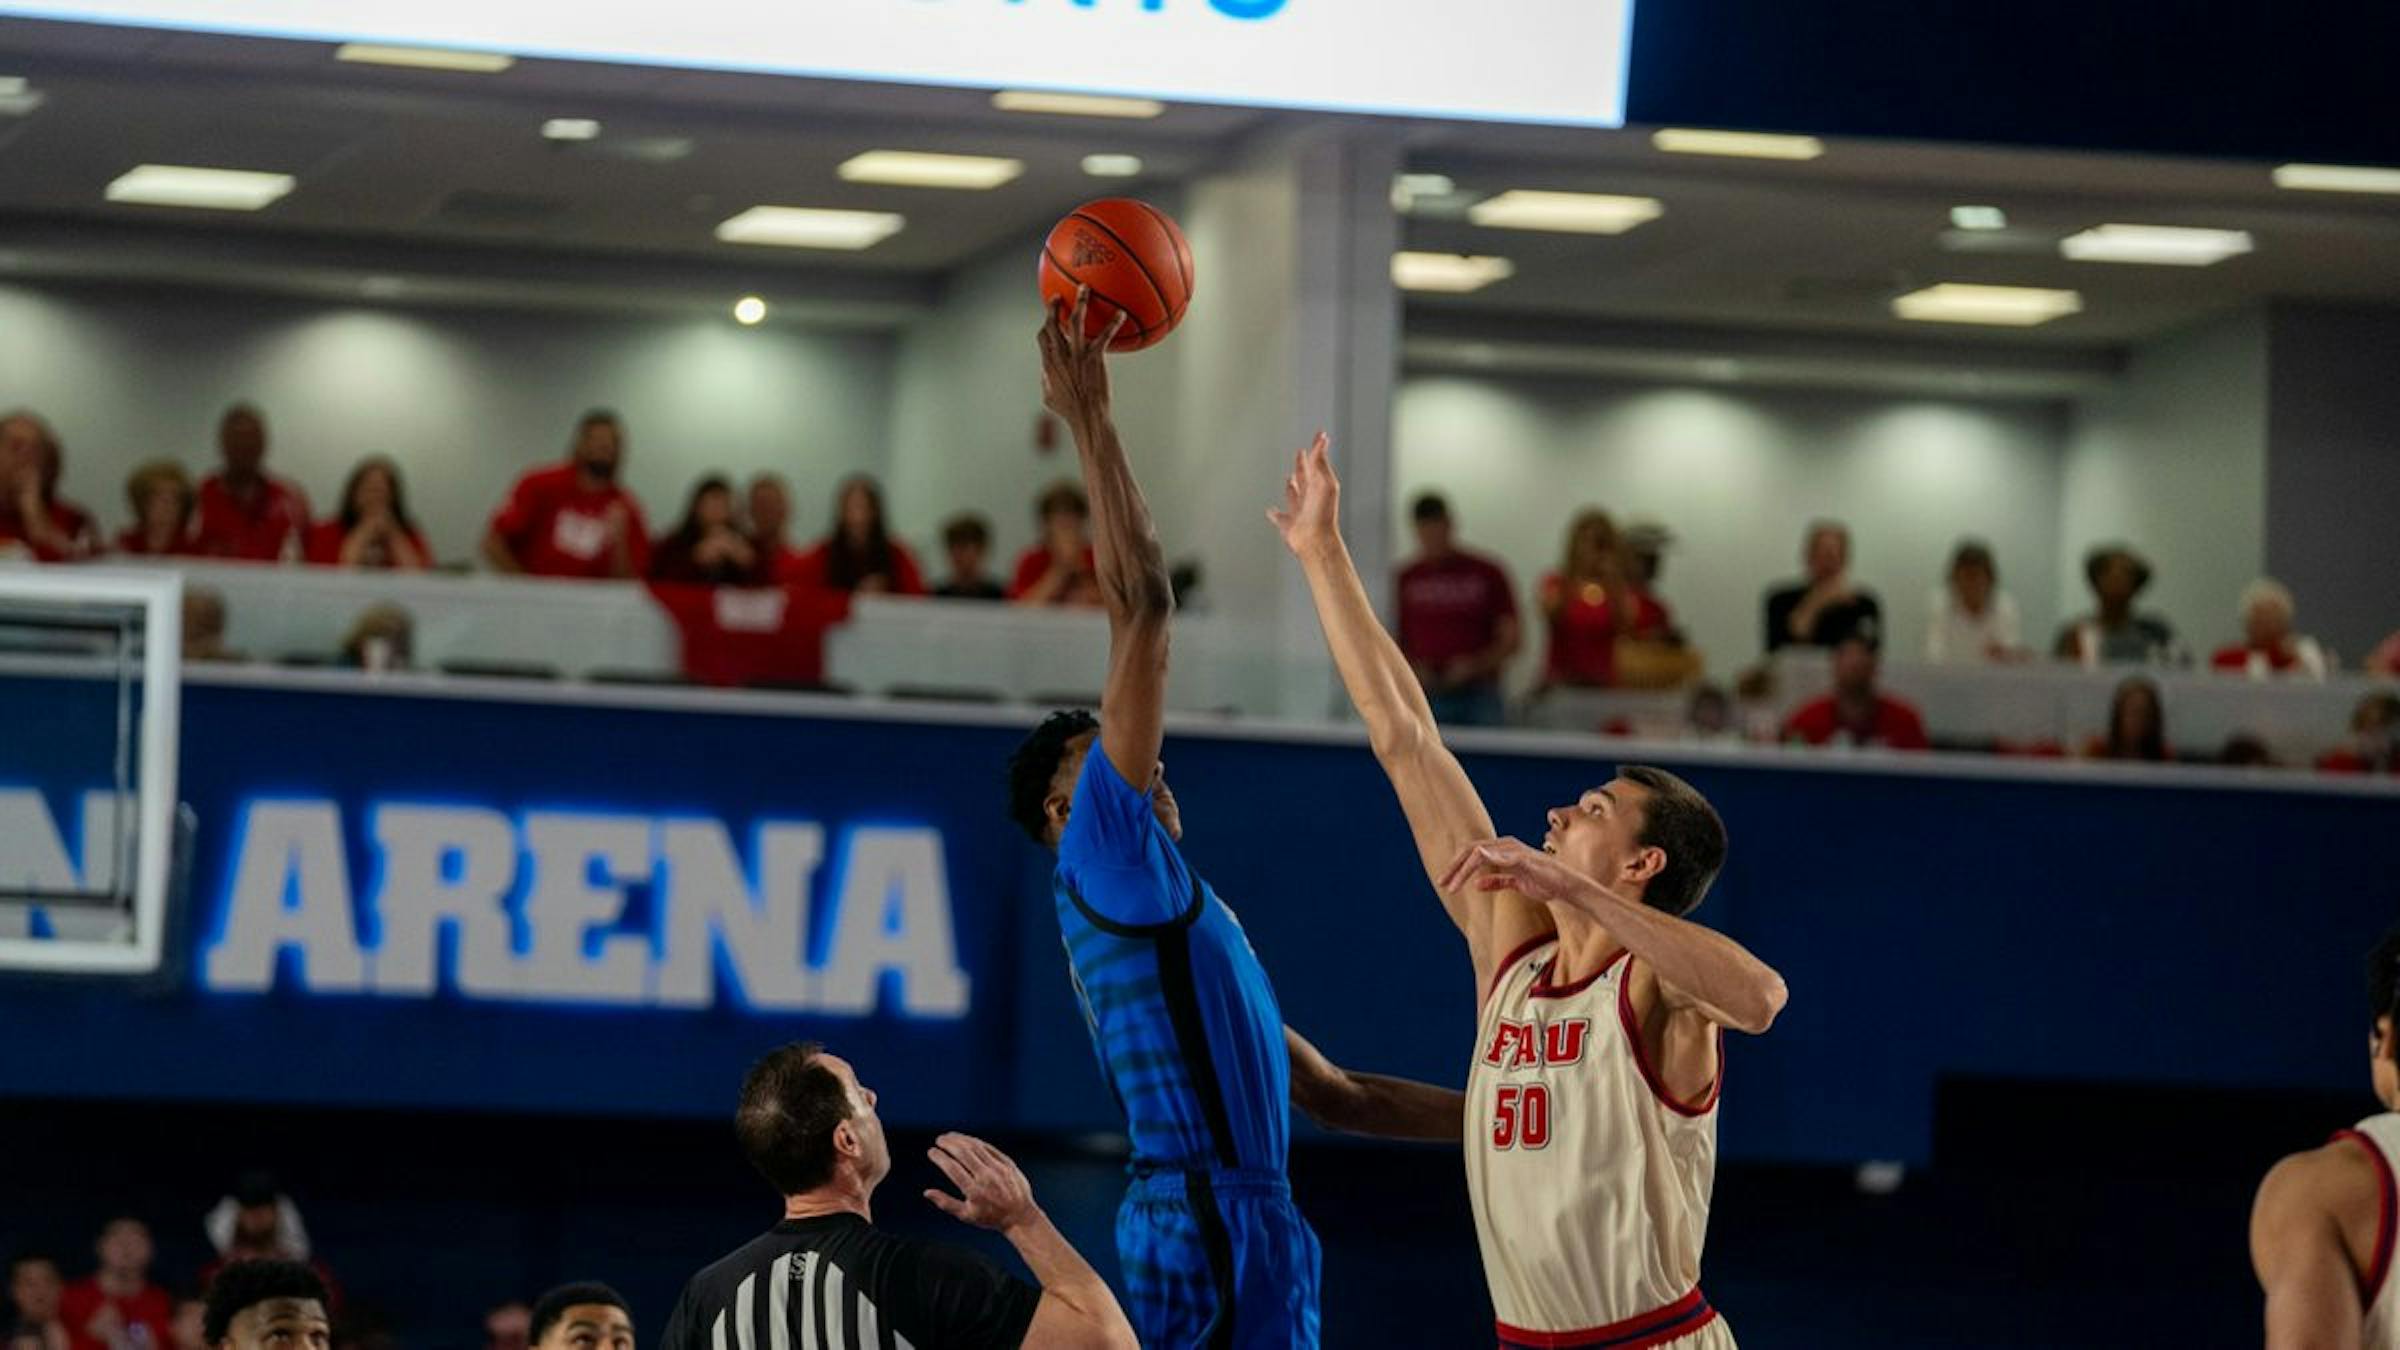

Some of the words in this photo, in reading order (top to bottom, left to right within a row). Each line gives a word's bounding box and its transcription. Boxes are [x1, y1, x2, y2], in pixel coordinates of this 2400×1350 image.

[207, 799, 969, 1017] ARENA
[1483, 1018, 1590, 1067] FAU
[1493, 1083, 1550, 1151] 50
